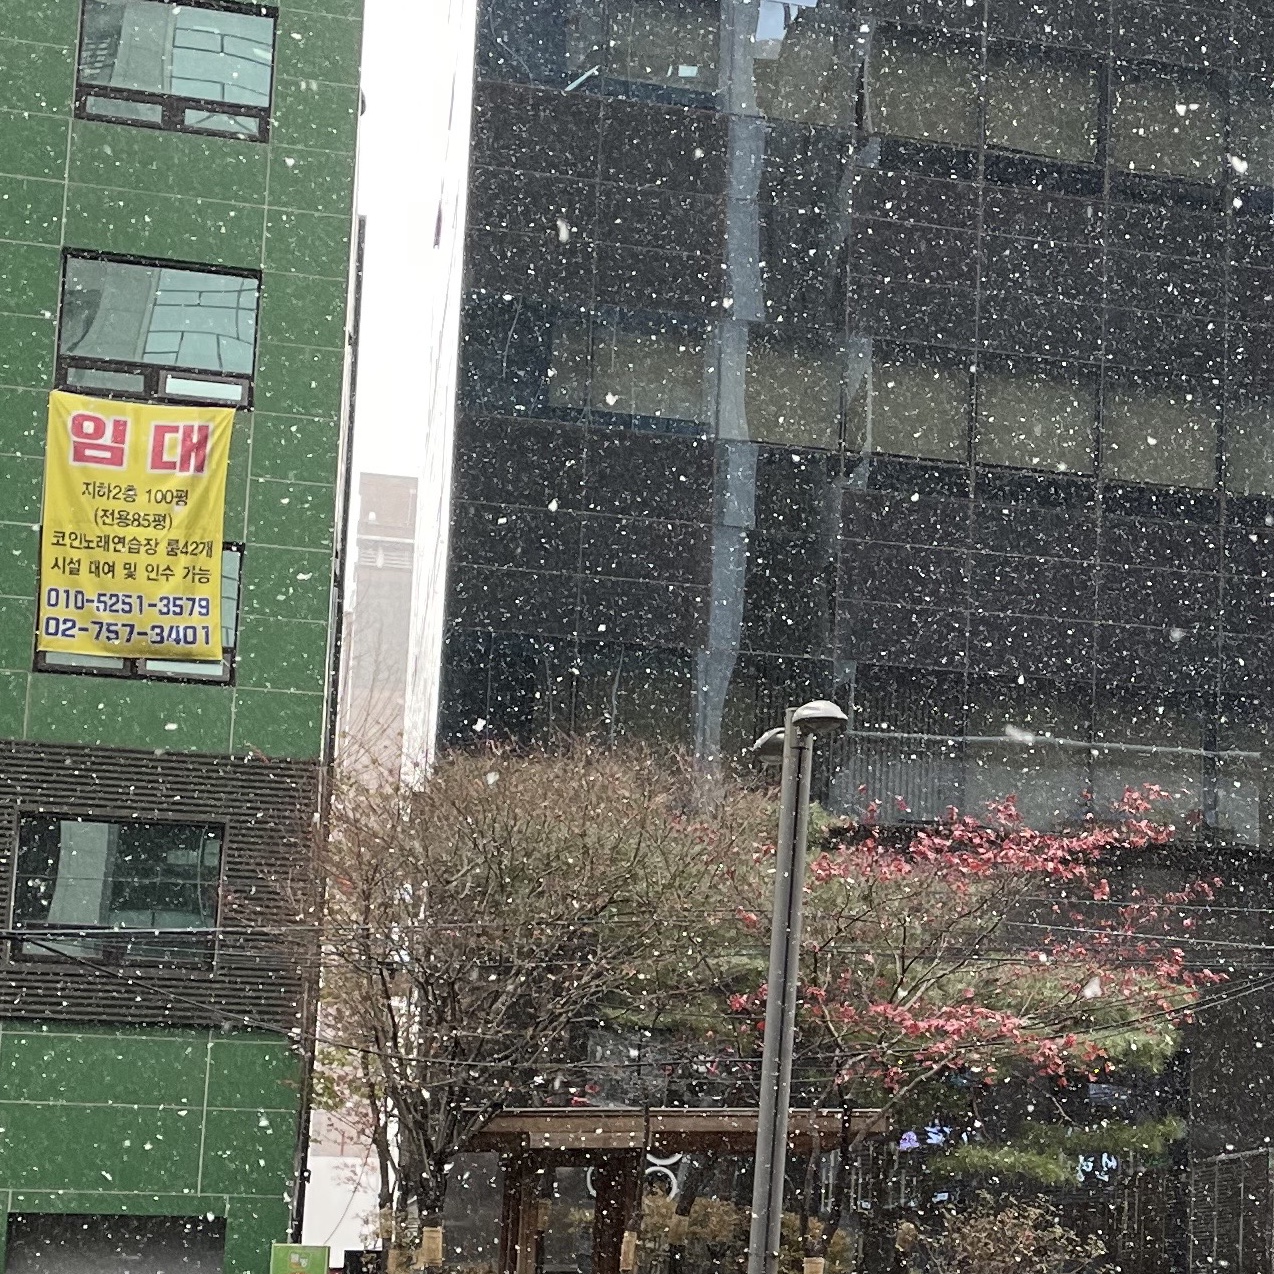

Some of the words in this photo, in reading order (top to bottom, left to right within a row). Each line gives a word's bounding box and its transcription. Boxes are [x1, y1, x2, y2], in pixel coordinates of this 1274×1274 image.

[82, 481, 138, 501] 지하2층
[146, 489, 189, 507] 100평
[94, 506, 173, 531] (전용85평)
[51, 530, 159, 556] 코인노래연습장
[166, 540, 213, 559] 룸42개
[51, 556, 82, 576] 시설
[89, 560, 116, 579] 대여
[123, 562, 137, 580] 및
[145, 563, 175, 582] 인수
[182, 567, 212, 584] 가능
[46, 587, 210, 617] 010-5251-3579
[44, 616, 210, 646] 02-757-3401
